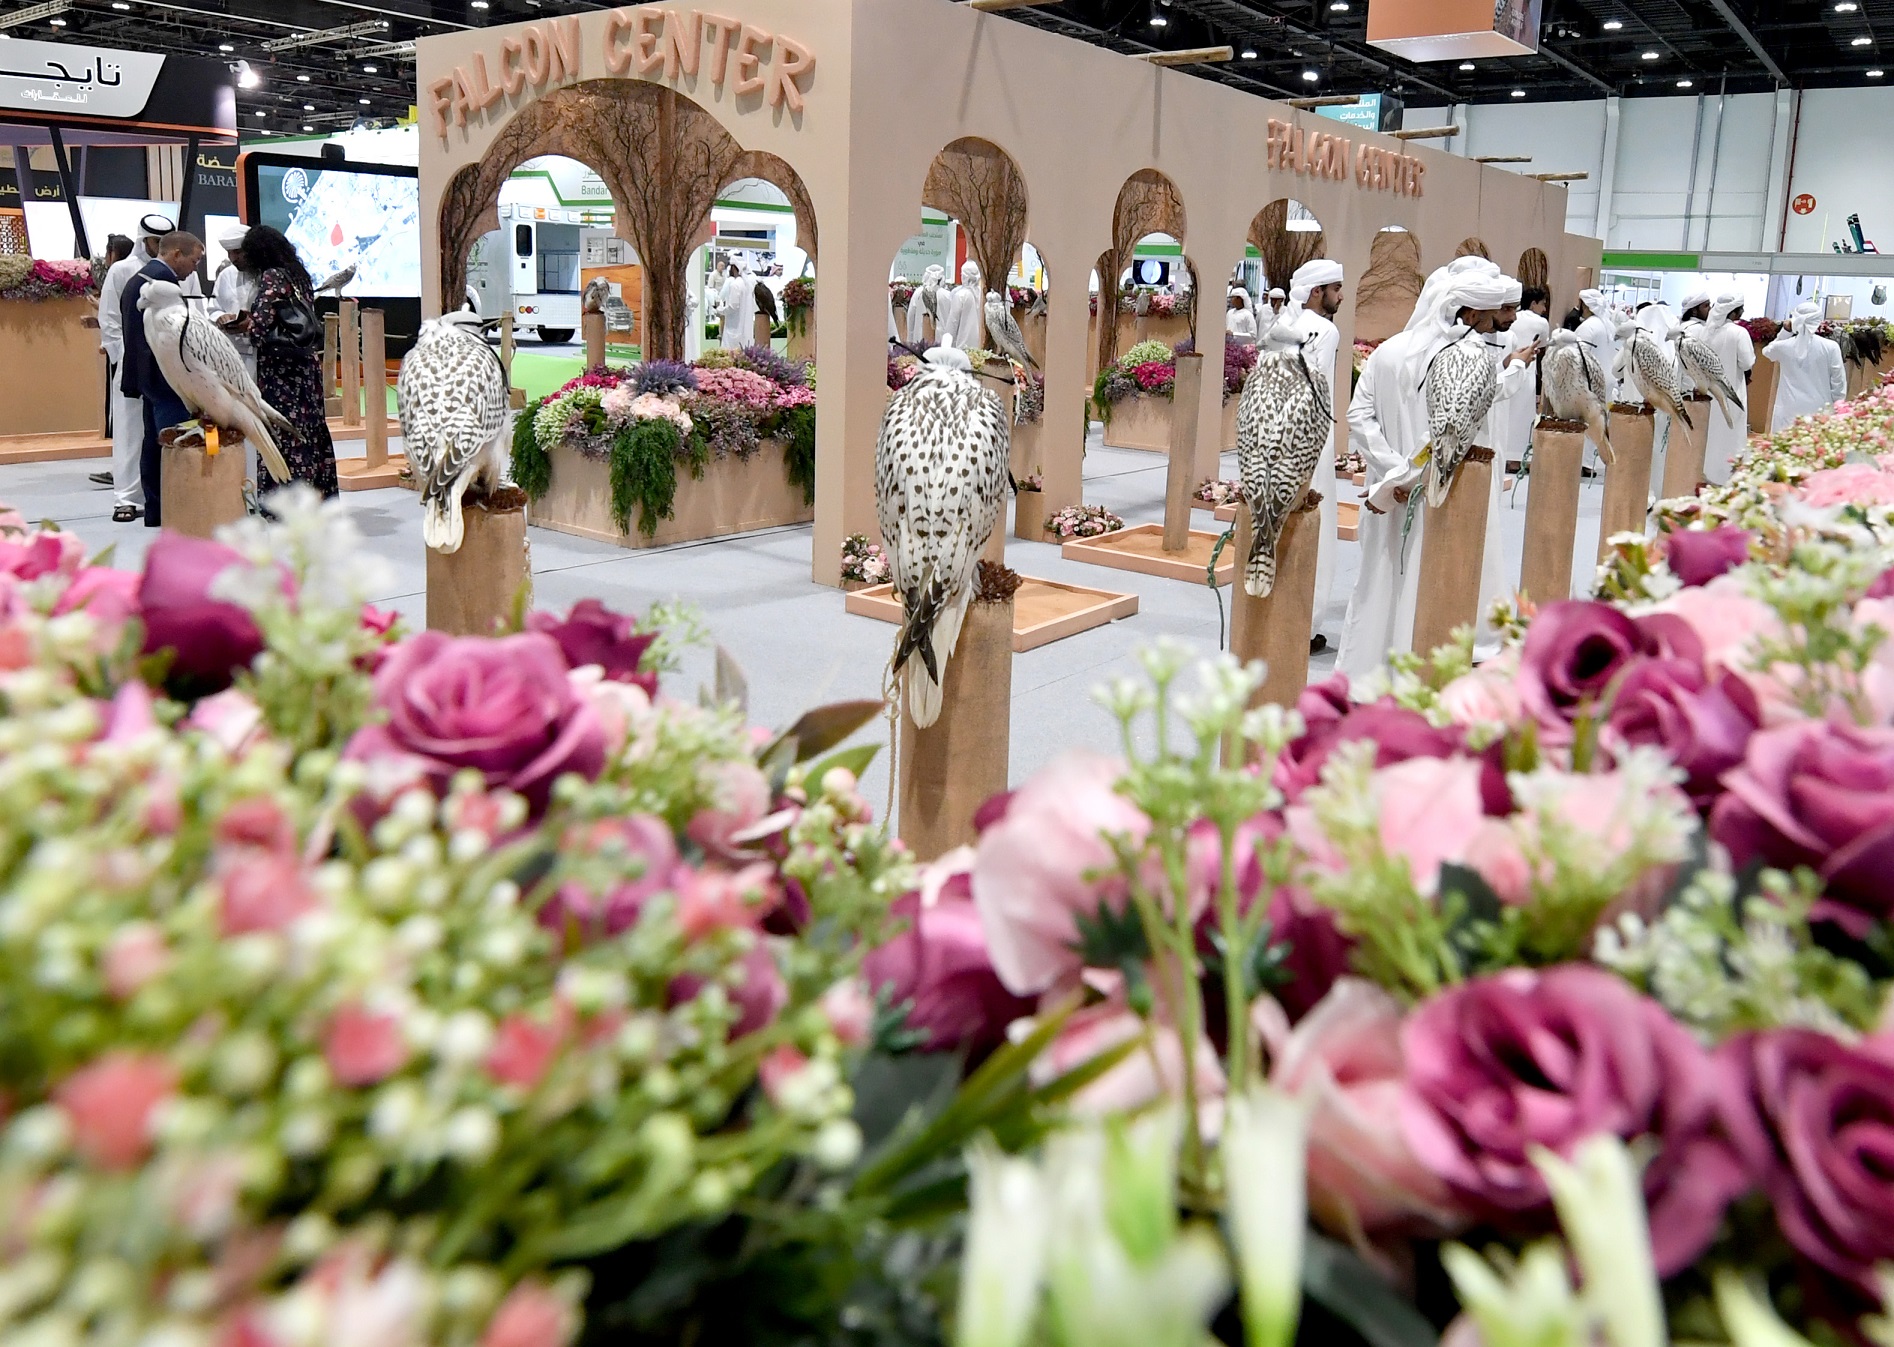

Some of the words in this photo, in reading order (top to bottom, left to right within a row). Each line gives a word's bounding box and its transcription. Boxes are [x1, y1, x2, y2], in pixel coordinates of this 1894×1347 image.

[0, 56, 121, 91] تايج
[427, 15, 580, 138] FALCON
[603, 8, 816, 112] CENTER
[1339, 111, 1376, 120] والخدمات
[1267, 118, 1351, 181] FALCON
[1356, 143, 1427, 198] CENTER
[34, 184, 60, 198] أرض
